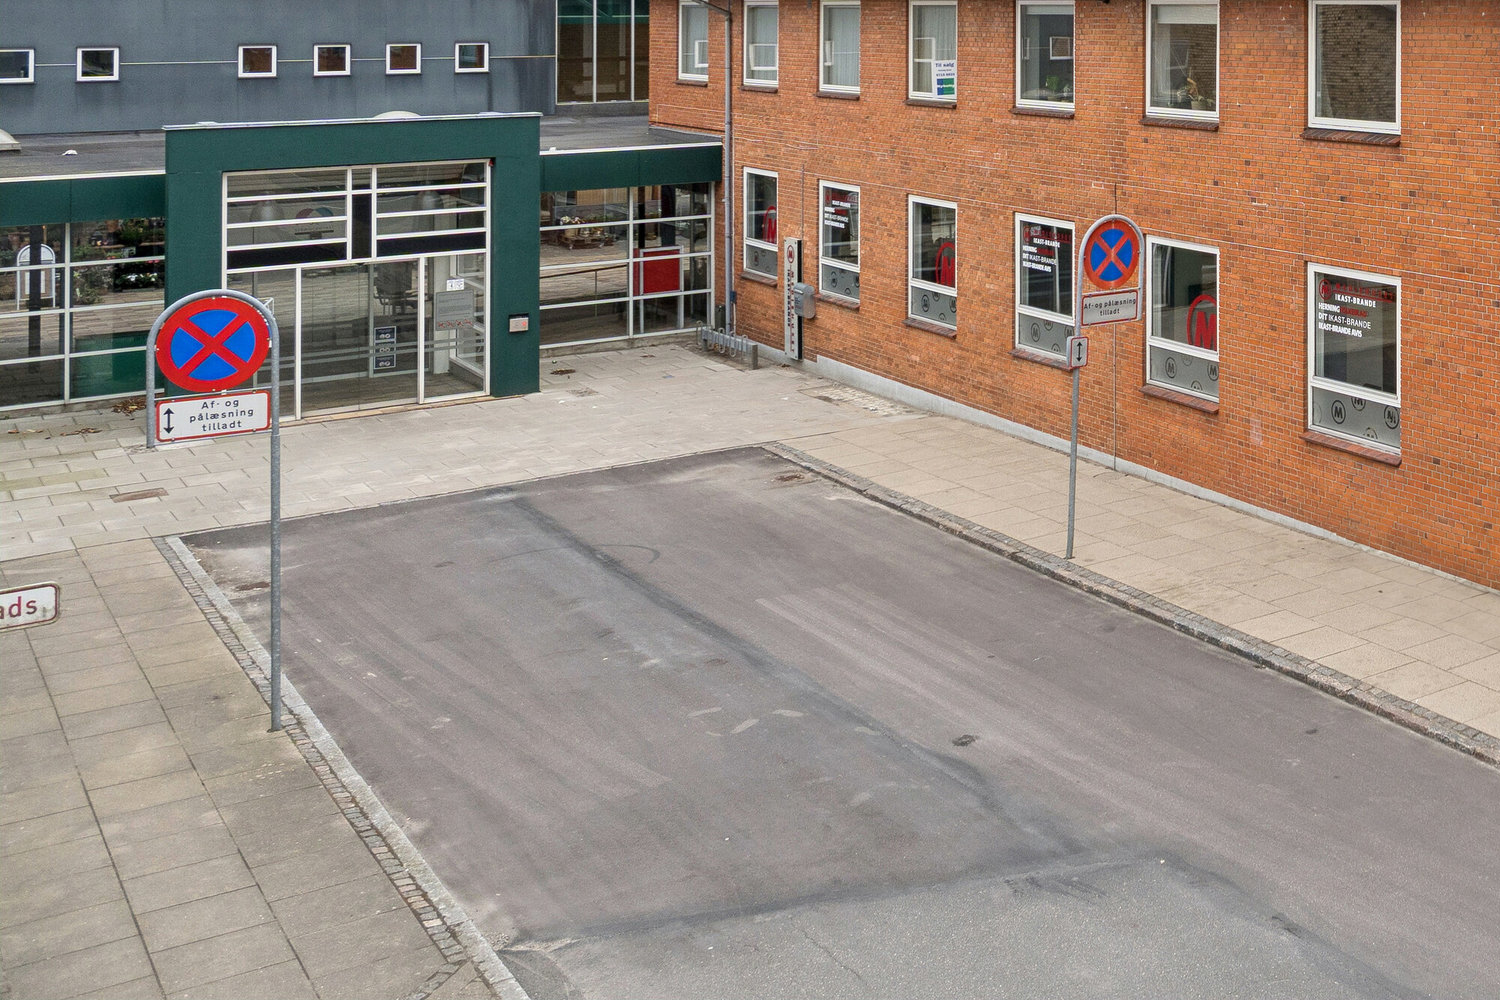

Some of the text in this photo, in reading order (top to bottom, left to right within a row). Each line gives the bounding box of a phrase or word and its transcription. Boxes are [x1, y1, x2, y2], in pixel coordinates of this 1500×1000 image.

[1104, 298, 1136, 308] pålæsning
[1335, 293, 1376, 308] IKAST-BRANDE
[1099, 308, 1120, 316] tilladt
[1318, 312, 1372, 330] DIT IKAST-BRANDE
[1194, 311, 1217, 352] M
[201, 399, 240, 410] Af- og
[189, 409, 254, 423] pålæsning
[202, 421, 242, 432] tilladt
